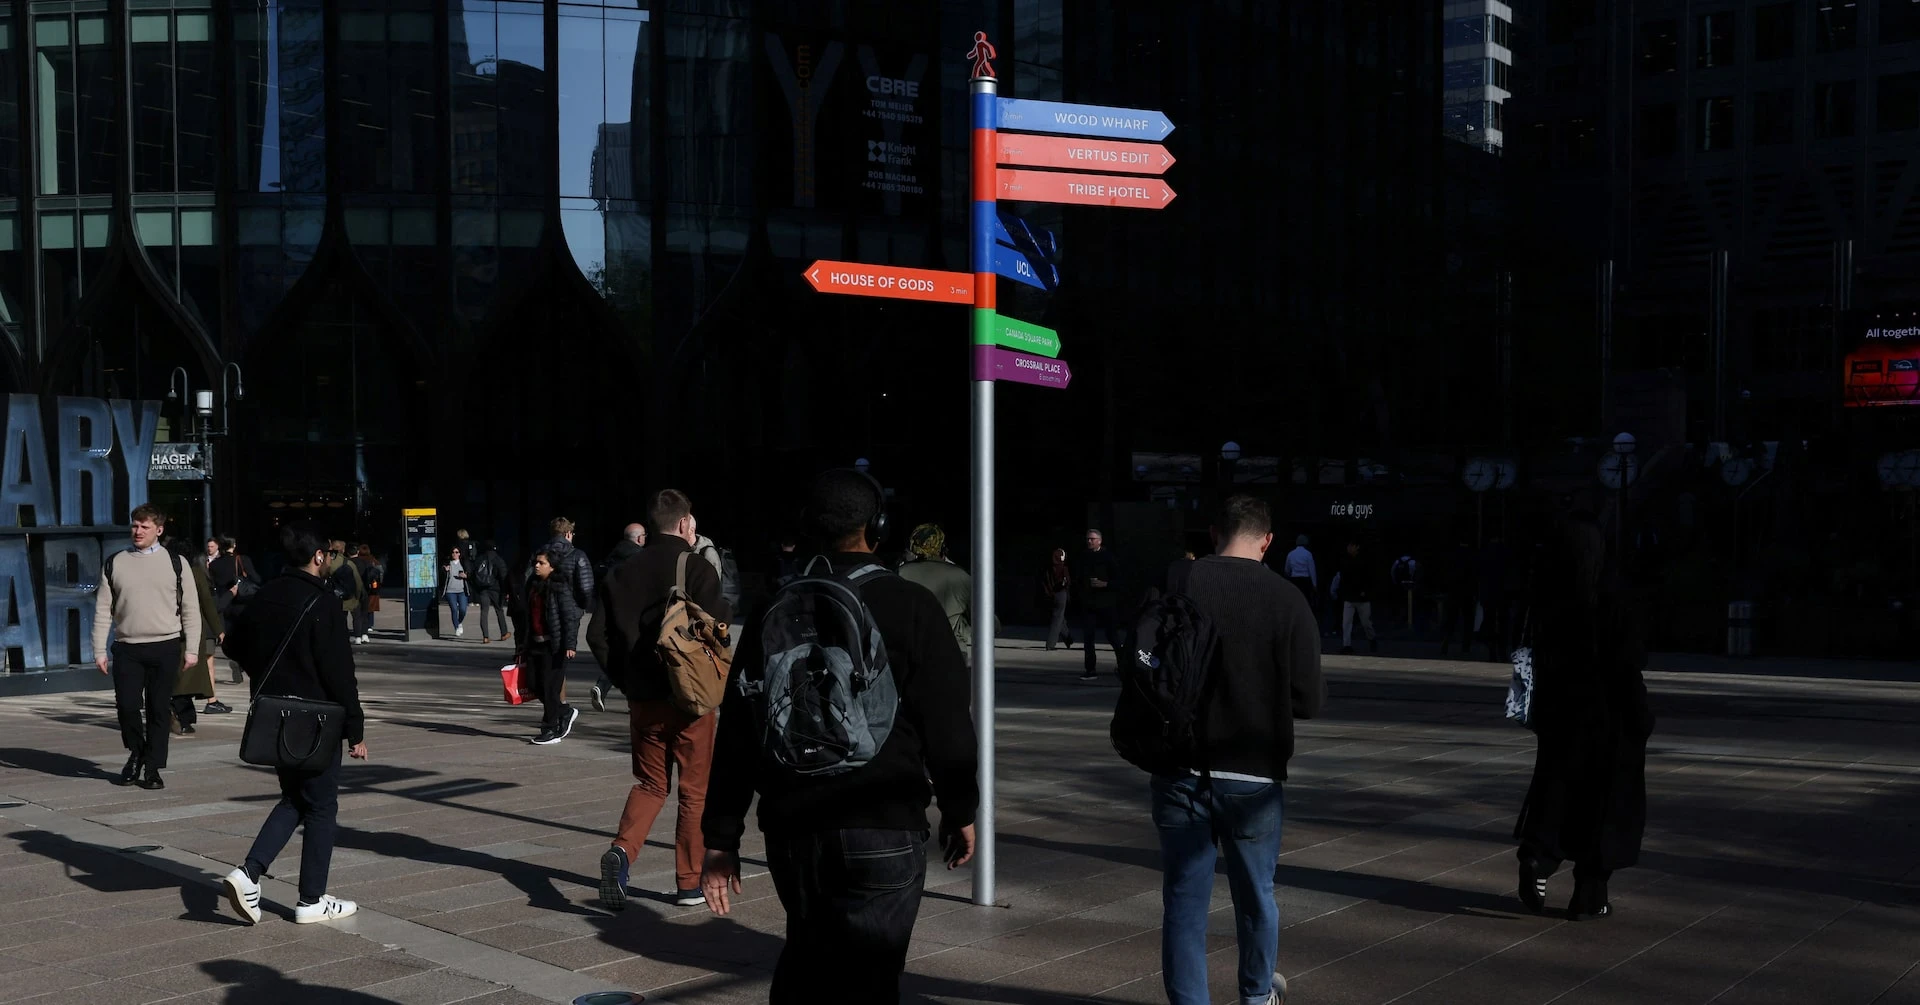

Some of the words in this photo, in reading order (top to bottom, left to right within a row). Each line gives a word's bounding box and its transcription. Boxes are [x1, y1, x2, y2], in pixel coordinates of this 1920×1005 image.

[866, 75, 919, 97] CBRE
[1054, 112, 1098, 126] WOOD
[1101, 116, 1149, 130] WHARF
[888, 143, 916, 157] Knight
[1068, 148, 1118, 162] VERTUS
[1121, 152, 1149, 164] EDIT
[888, 154, 912, 166] Frank
[867, 170, 884, 180] ROB
[1068, 183, 1105, 196] TRIBE
[1108, 186, 1150, 199] HOTEL
[1016, 259, 1031, 277] UCL
[830, 272, 875, 287] HOUSE
[878, 276, 895, 288] OF
[898, 278, 934, 292] GODS
[950, 286, 955, 294] 3
[1005, 327, 1024, 340] CANADA
[1024, 333, 1042, 345] SQUARE
[1041, 338, 1053, 347] PARK
[1866, 328, 1880, 338] All
[1015, 358, 1044, 371] CROSSRAIL
[1044, 363, 1061, 374] PLACE
[0, 393, 163, 527] ARY
[151, 453, 195, 465] HAGEN
[1331, 500, 1346, 515] rice
[1355, 504, 1374, 519] guys
